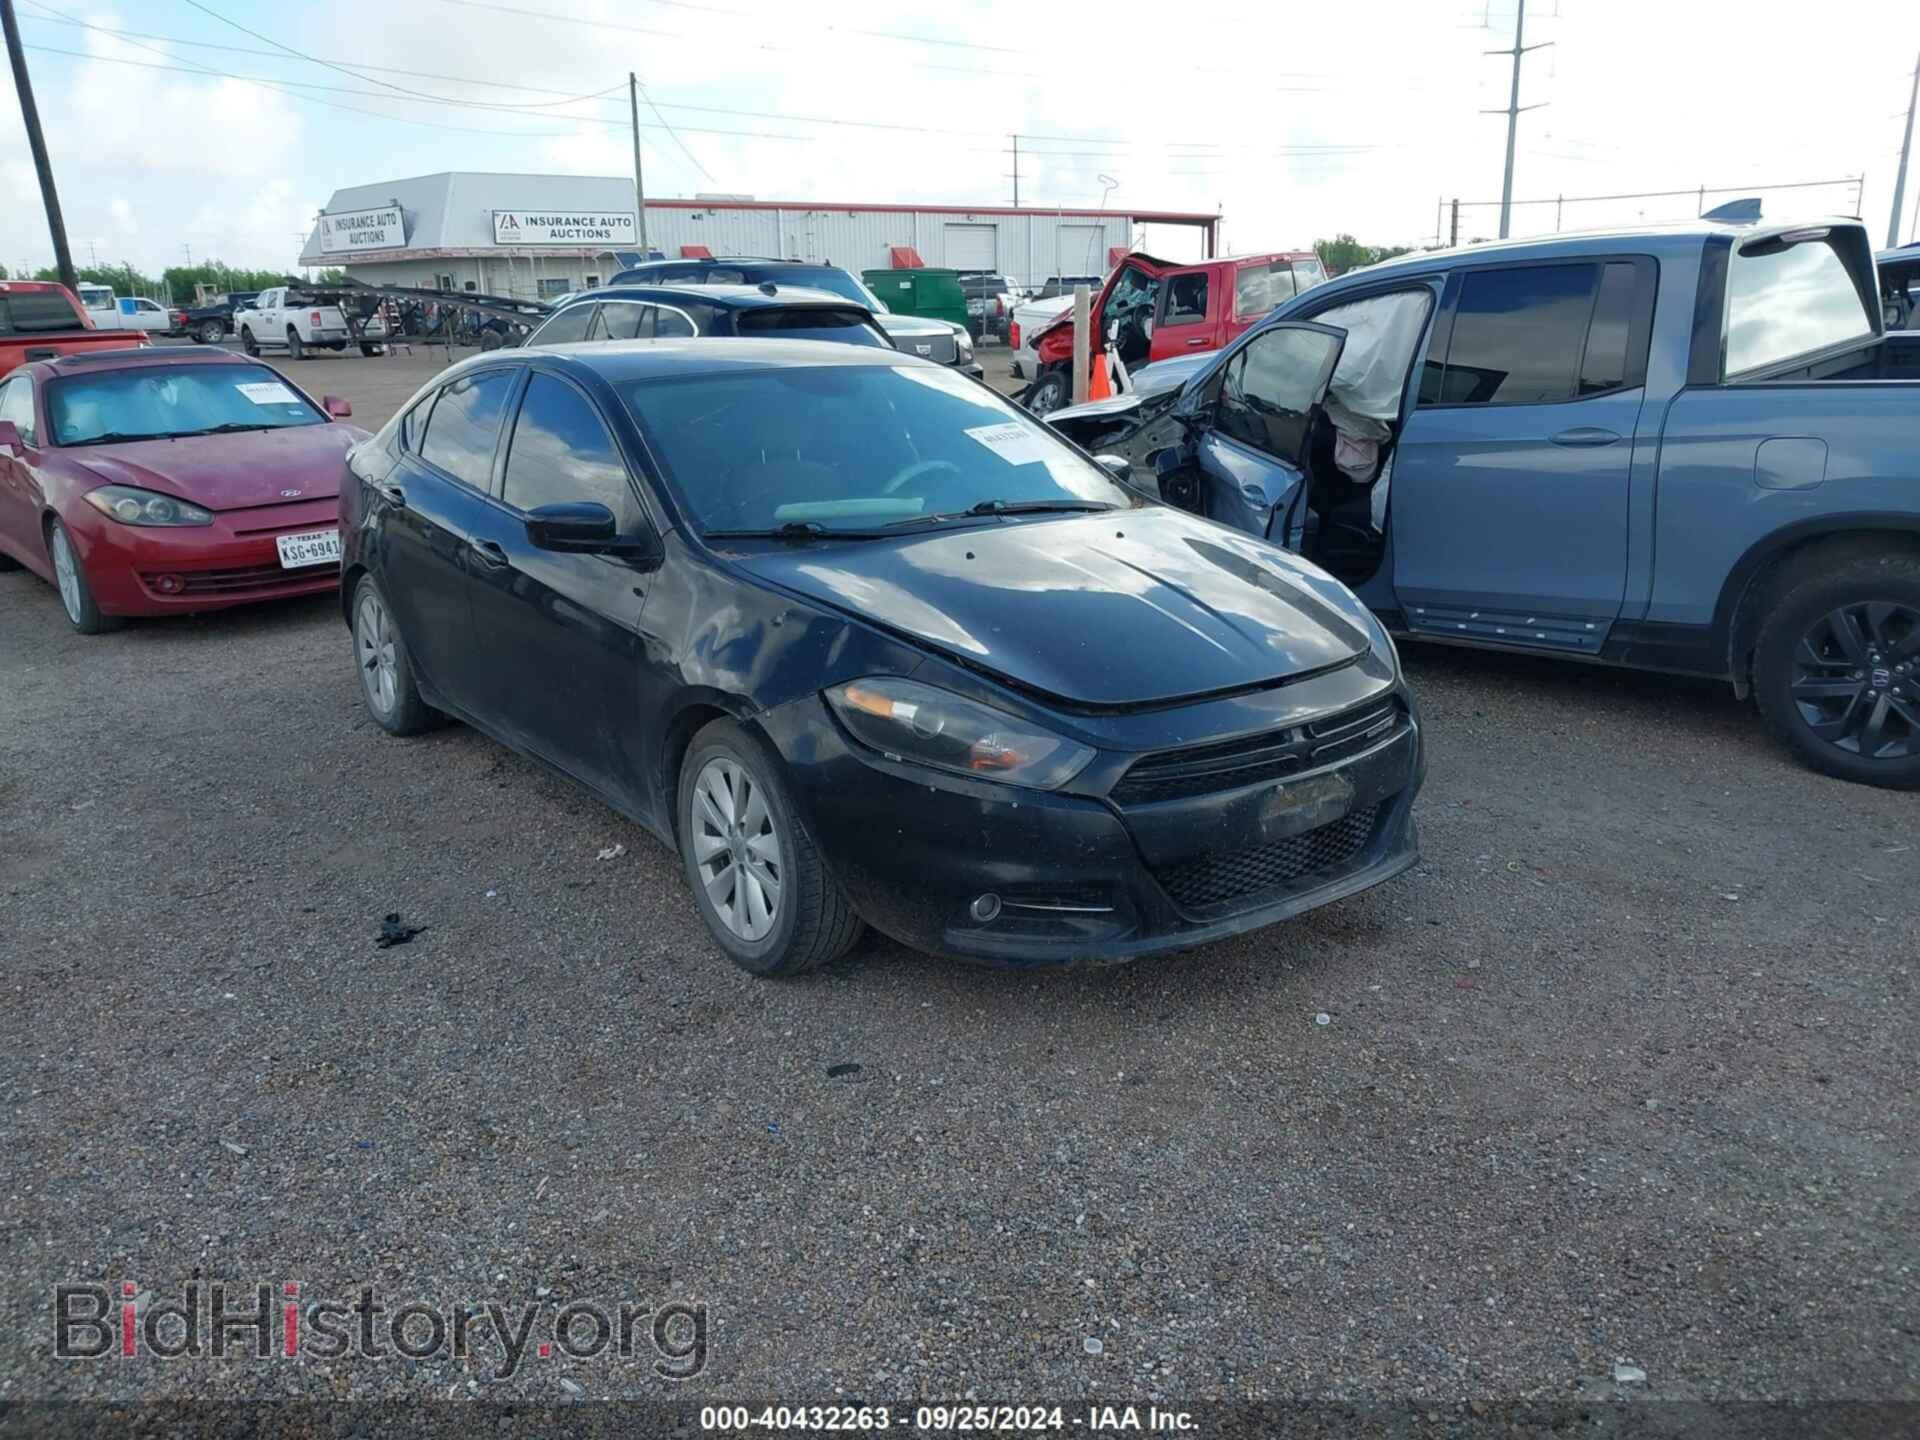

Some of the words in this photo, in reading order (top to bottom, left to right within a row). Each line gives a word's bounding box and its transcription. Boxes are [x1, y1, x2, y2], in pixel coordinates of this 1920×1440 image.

[335, 215, 375, 231] INSURANCE
[377, 212, 397, 226] AUTO
[525, 216, 596, 227] INSURANCE
[600, 217, 632, 228] AUTO
[350, 230, 385, 244] AUCTIONS
[550, 228, 612, 239] AUCTIONS
[296, 533, 322, 542] TEXAS
